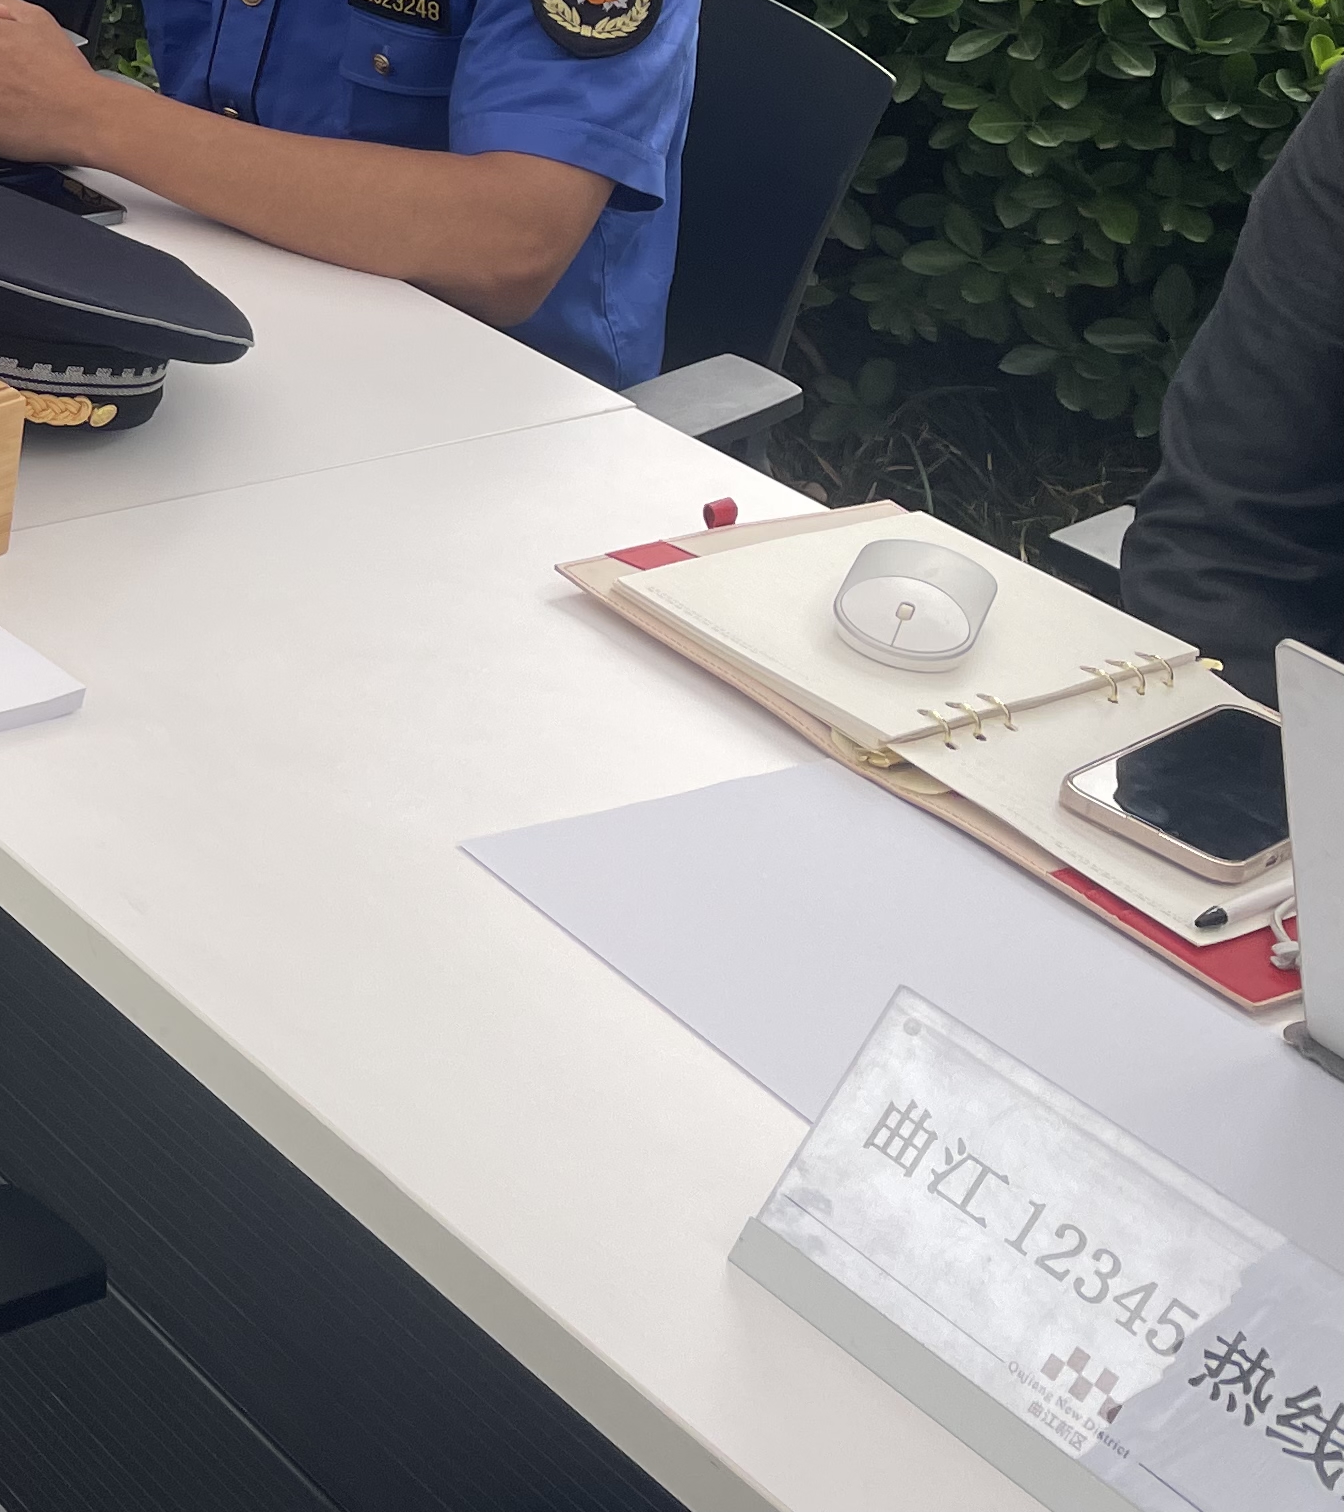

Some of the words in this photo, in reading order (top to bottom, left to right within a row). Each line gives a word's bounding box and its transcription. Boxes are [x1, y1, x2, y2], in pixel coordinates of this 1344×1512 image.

[863, 1099, 1009, 1229] 曲江
[1004, 1200, 1200, 1356] 12345
[1189, 1331, 1344, 1491] 热线
[1008, 1361, 1053, 1402] Qujiang
[1055, 1396, 1082, 1421] New
[1083, 1417, 1130, 1459] District
[1028, 1401, 1088, 1451] 曲江新区
